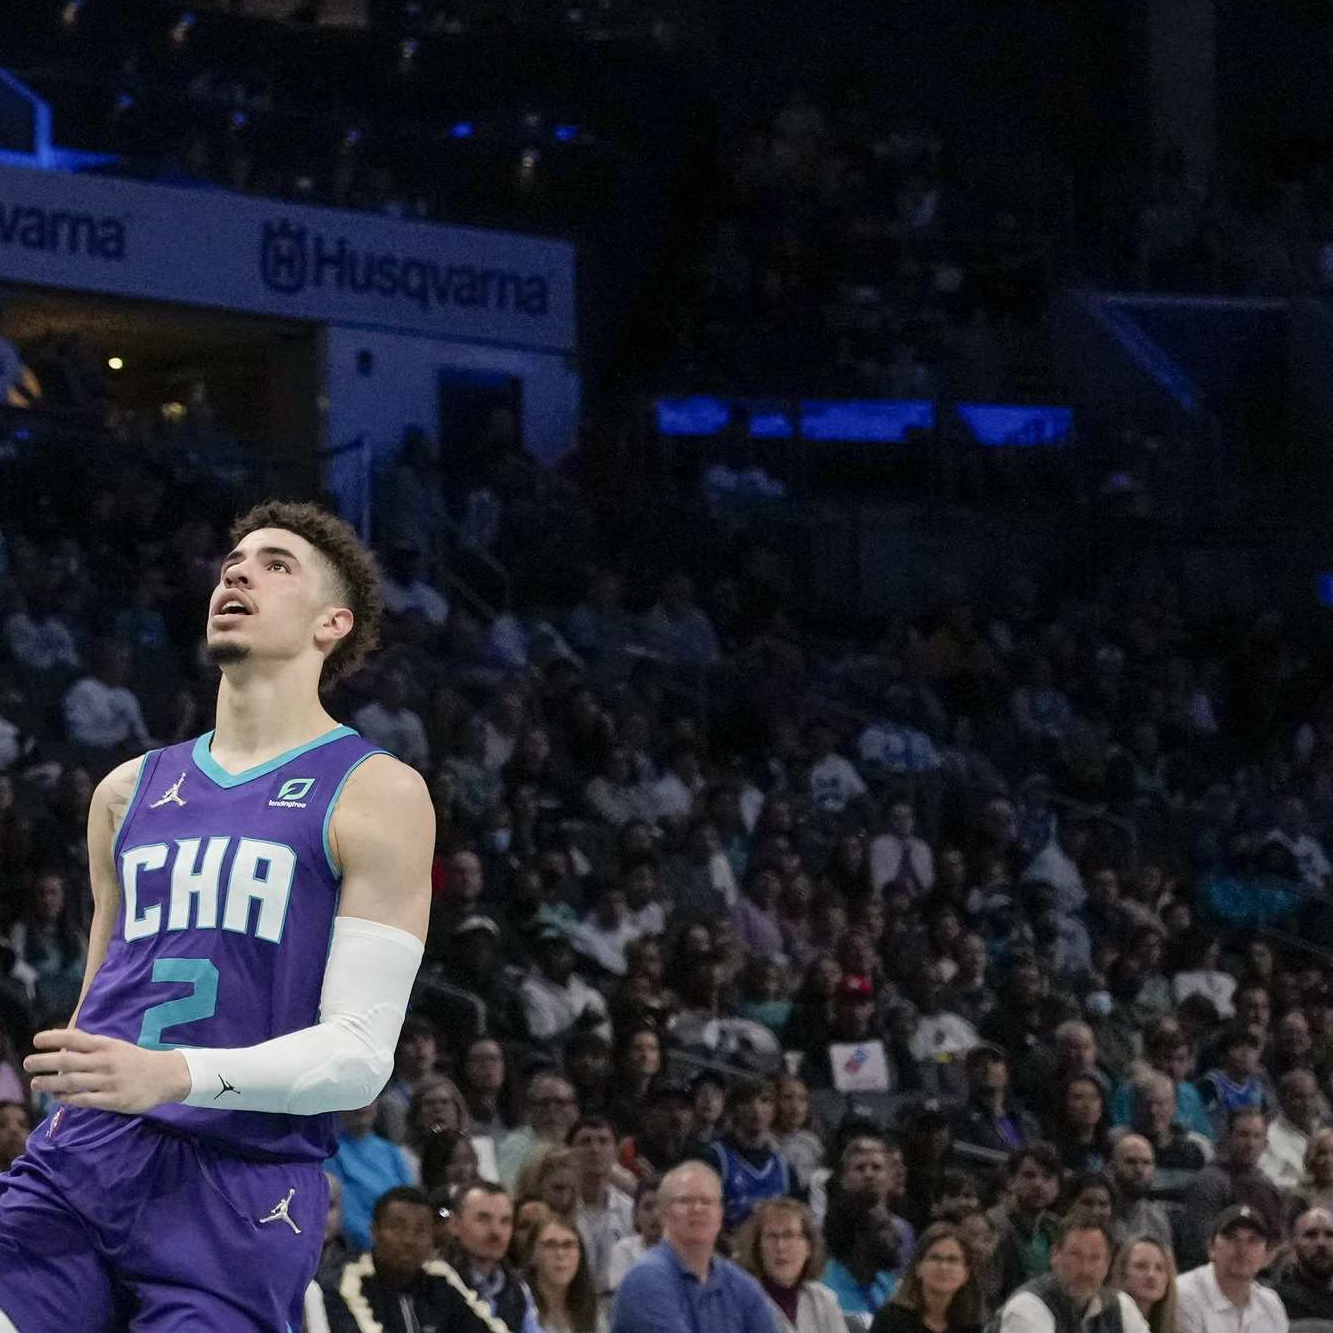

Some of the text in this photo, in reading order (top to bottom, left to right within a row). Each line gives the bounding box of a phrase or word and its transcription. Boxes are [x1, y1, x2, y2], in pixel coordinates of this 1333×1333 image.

[313, 236, 549, 315] Husqvarna
[120, 836, 298, 945] CHA
[136, 958, 221, 1052] 2
